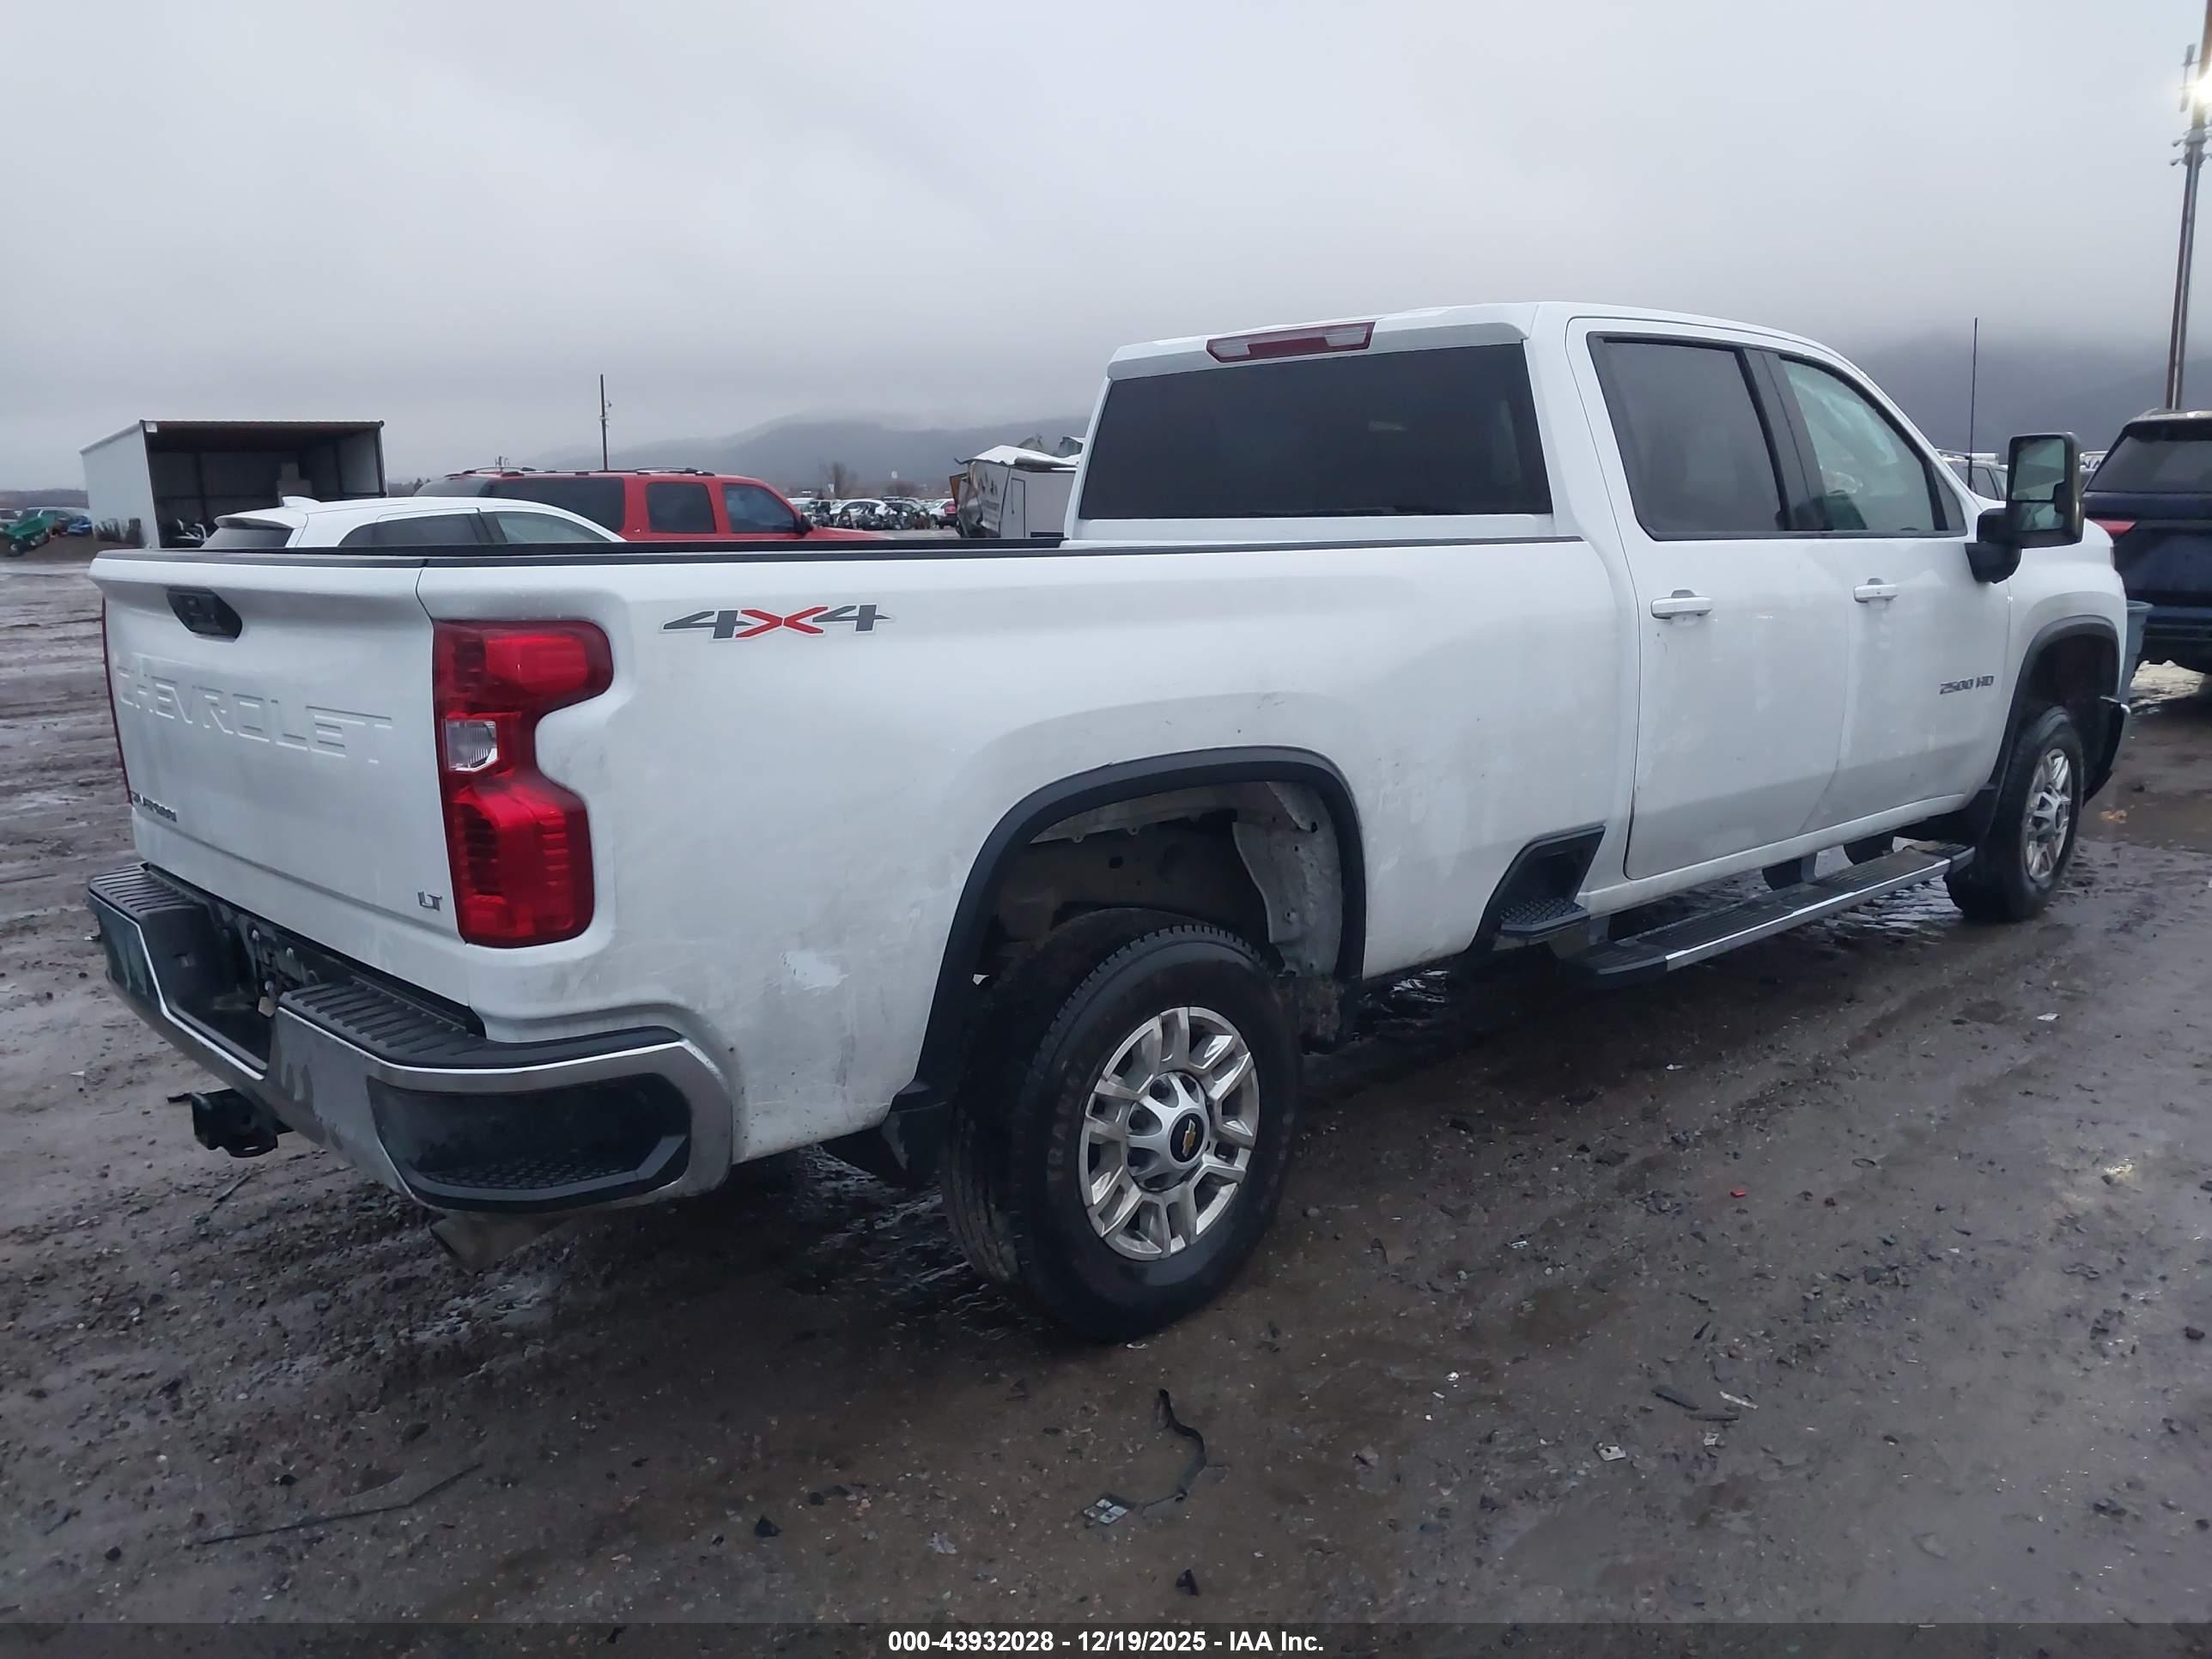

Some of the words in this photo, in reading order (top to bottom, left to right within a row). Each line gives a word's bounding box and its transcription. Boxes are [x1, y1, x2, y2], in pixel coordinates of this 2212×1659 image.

[1939, 678, 1974, 695] 2500
[1975, 675, 1995, 689] HD
[116, 665, 392, 763] CHEVROLET
[417, 891, 443, 911] LT
